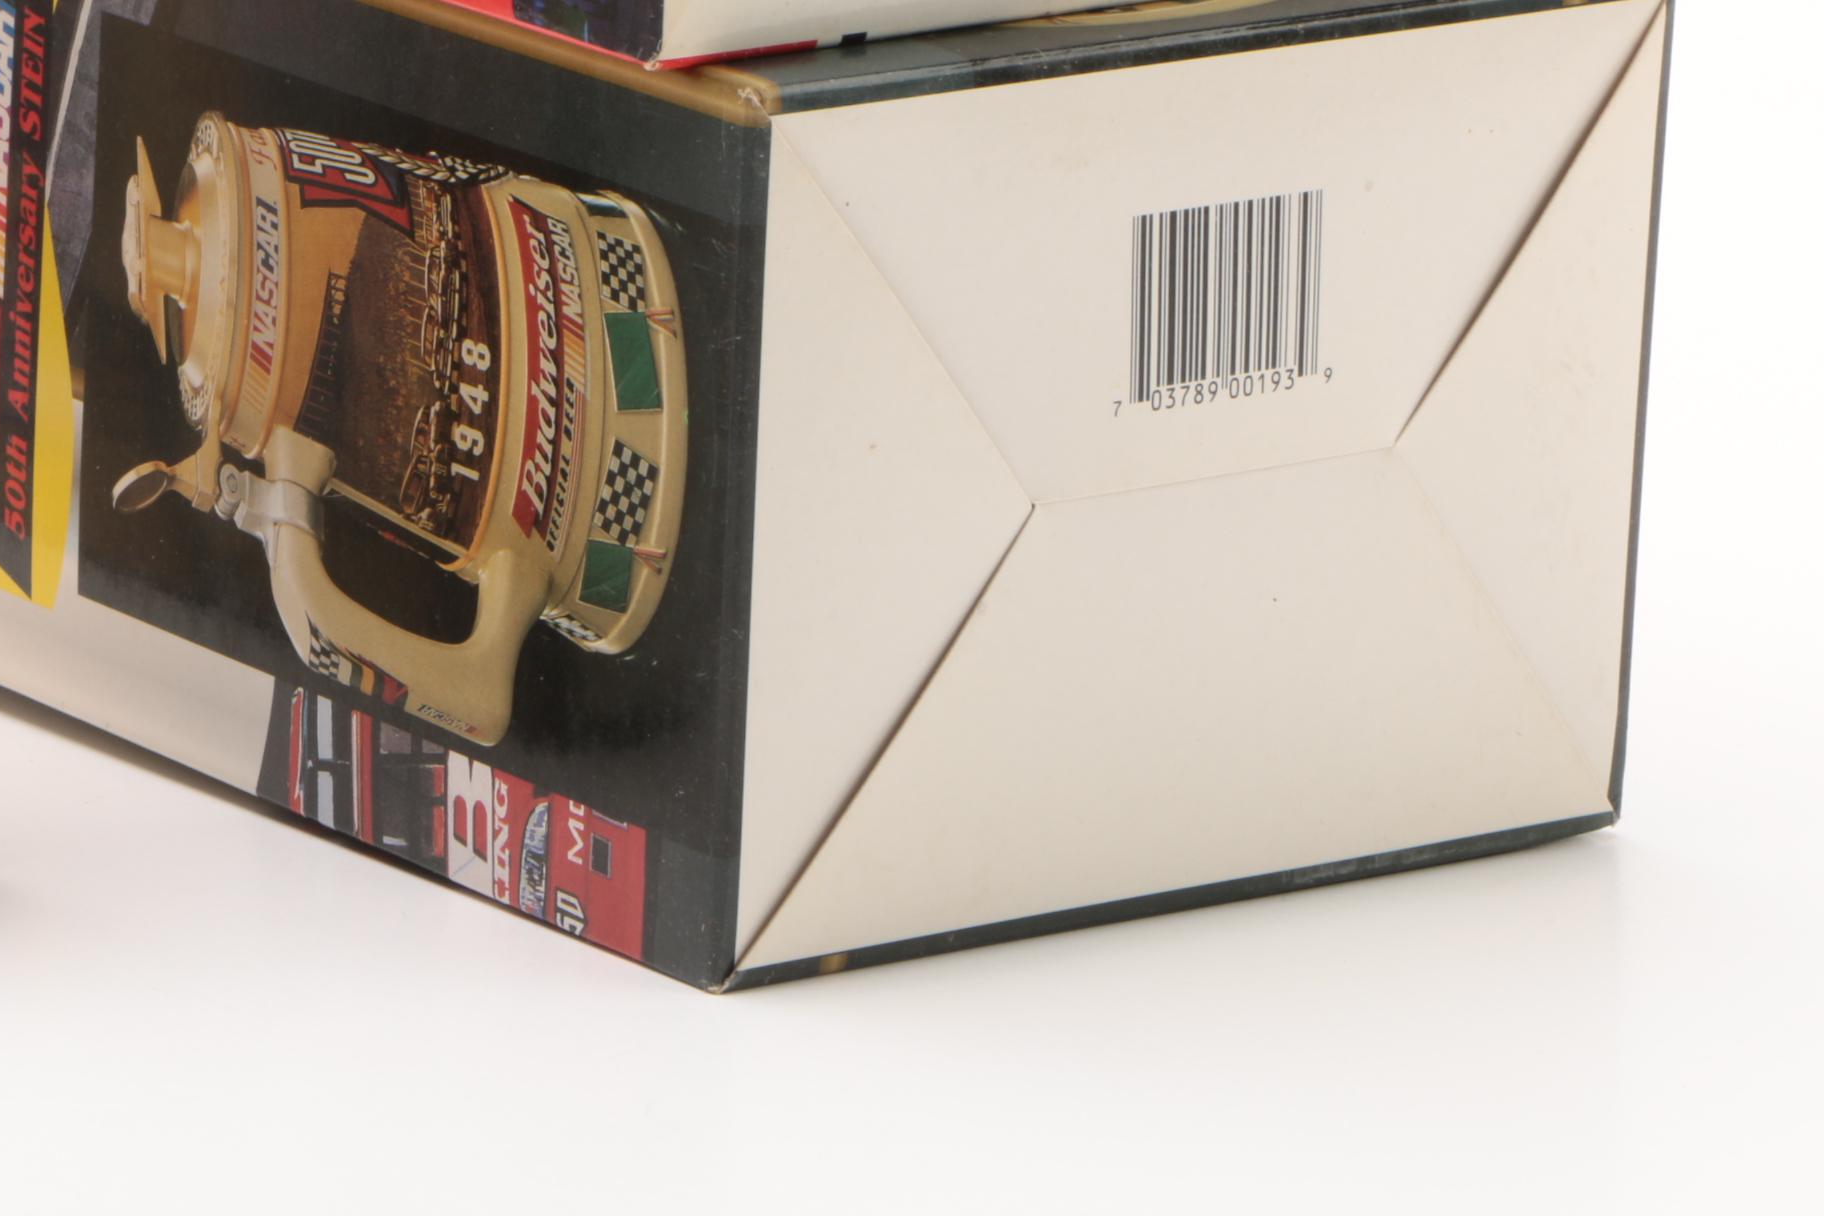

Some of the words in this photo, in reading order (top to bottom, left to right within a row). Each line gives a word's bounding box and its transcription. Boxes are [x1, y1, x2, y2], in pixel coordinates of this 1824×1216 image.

[19, 6, 46, 141] STEIN
[7, 149, 45, 423] Anniversary
[251, 197, 279, 357] NASCAR
[547, 218, 583, 324] NASCAR
[451, 339, 491, 482] 1948
[521, 214, 558, 519] Budweiser
[1111, 400, 1122, 417] 7
[1151, 381, 1218, 411] 03789
[1229, 369, 1295, 399] 00193
[1323, 367, 1333, 384] 9
[4, 434, 28, 541] 50th
